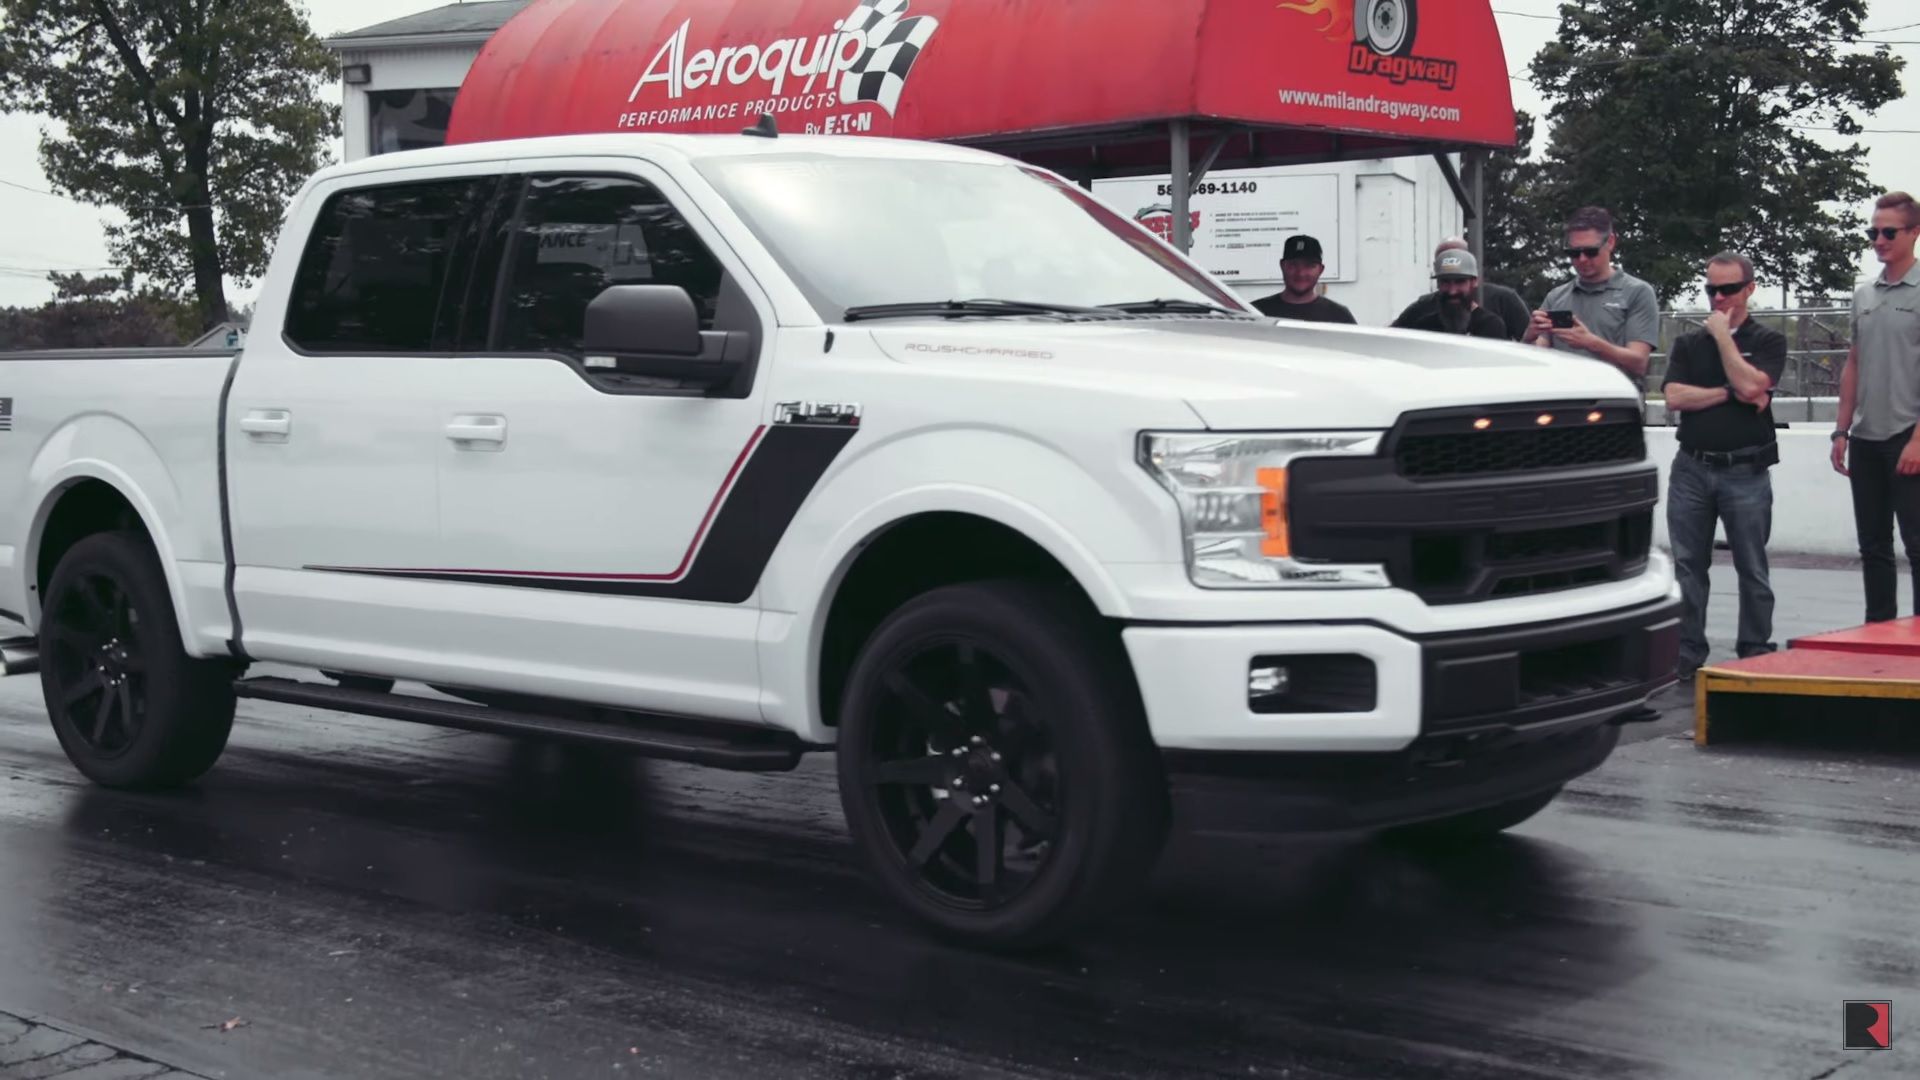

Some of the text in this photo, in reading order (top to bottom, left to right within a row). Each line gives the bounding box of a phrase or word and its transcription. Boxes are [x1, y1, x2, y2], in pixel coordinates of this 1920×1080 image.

[628, 18, 867, 102] Aeroquip
[1349, 41, 1457, 90] Dragway
[618, 92, 836, 128] PERFORMANCE PRODUCTS
[1279, 89, 1460, 122] www.milandragway.com
[905, 343, 1053, 361] ROUSHCHARGED
